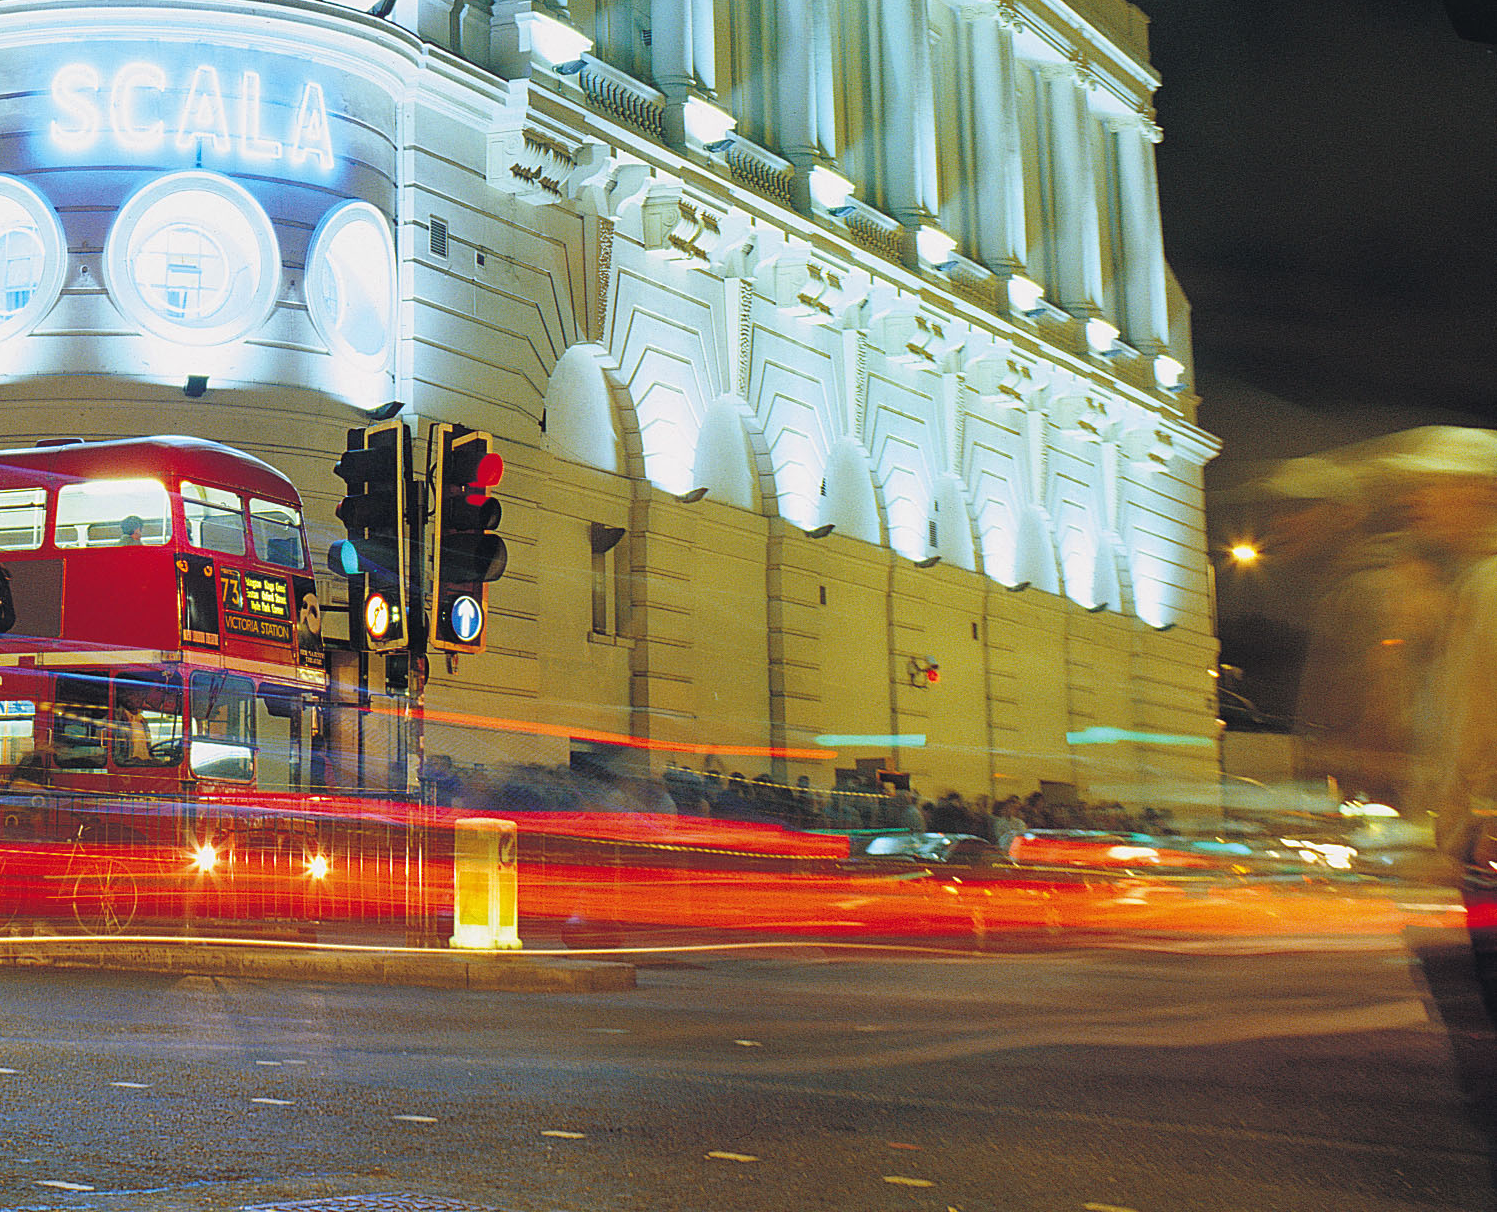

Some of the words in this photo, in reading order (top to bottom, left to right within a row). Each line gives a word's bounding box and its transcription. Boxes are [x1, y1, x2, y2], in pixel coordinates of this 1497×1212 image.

[50, 61, 335, 171] SCALA
[220, 577, 240, 605] 73
[225, 615, 259, 634] VICTORIA
[261, 622, 289, 639] STATION
